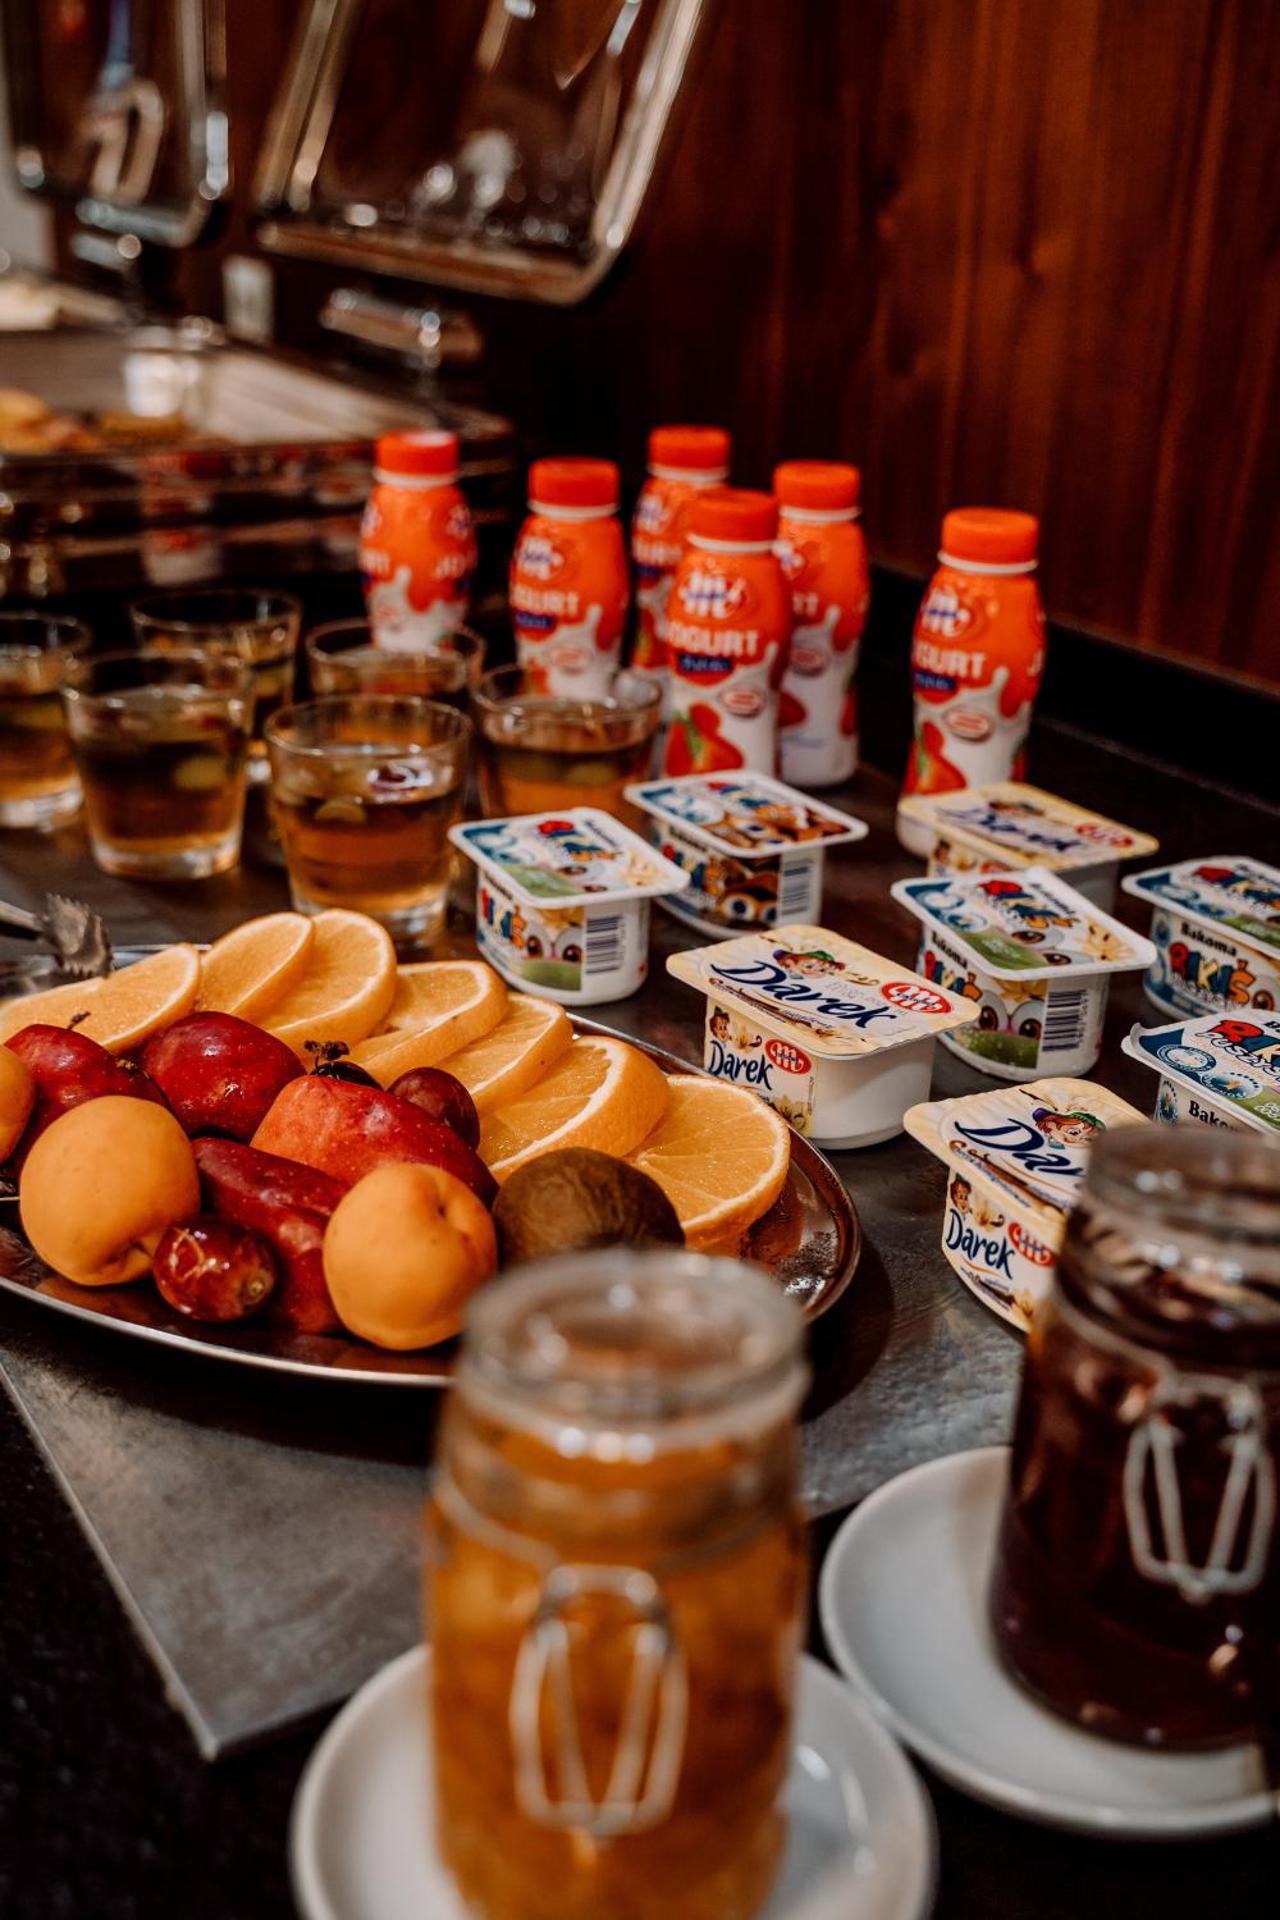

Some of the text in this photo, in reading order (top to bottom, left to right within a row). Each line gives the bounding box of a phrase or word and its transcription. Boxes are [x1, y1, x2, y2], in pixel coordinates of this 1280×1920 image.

[1181, 921, 1238, 957] Bakoma
[710, 960, 898, 1029] Darek
[707, 1040, 774, 1092] Darek
[1188, 1099, 1234, 1131] Bako
[945, 1207, 1016, 1281] Darek
